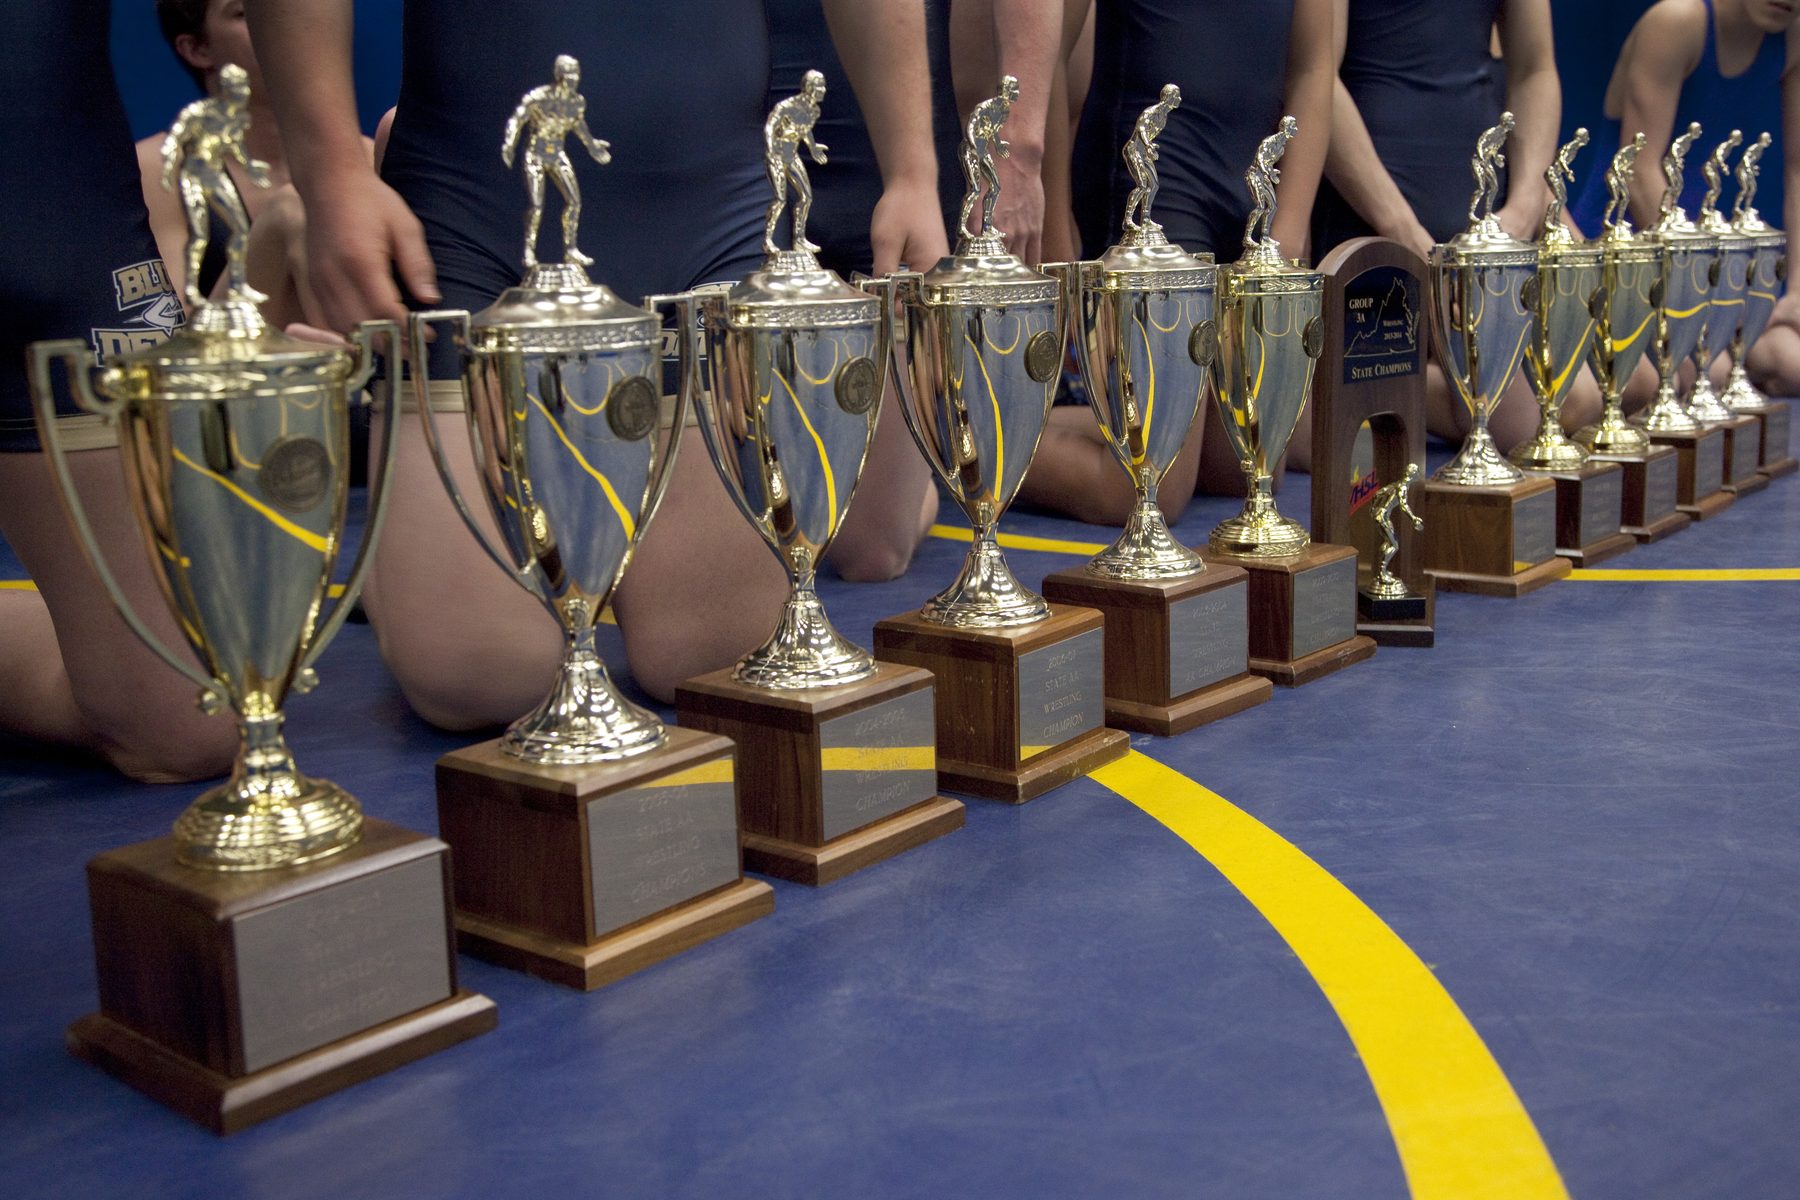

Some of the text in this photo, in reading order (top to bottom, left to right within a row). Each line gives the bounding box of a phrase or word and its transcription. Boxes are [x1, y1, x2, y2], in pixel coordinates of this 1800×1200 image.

[1349, 298, 1373, 309] GROUP
[1353, 362, 1412, 380] STATE CHAMPIONS
[1045, 674, 1066, 692] STATE
[1044, 690, 1082, 714] WRESTLING
[1043, 712, 1084, 739] CHAMPION
[856, 778, 912, 813] CHAMPION
